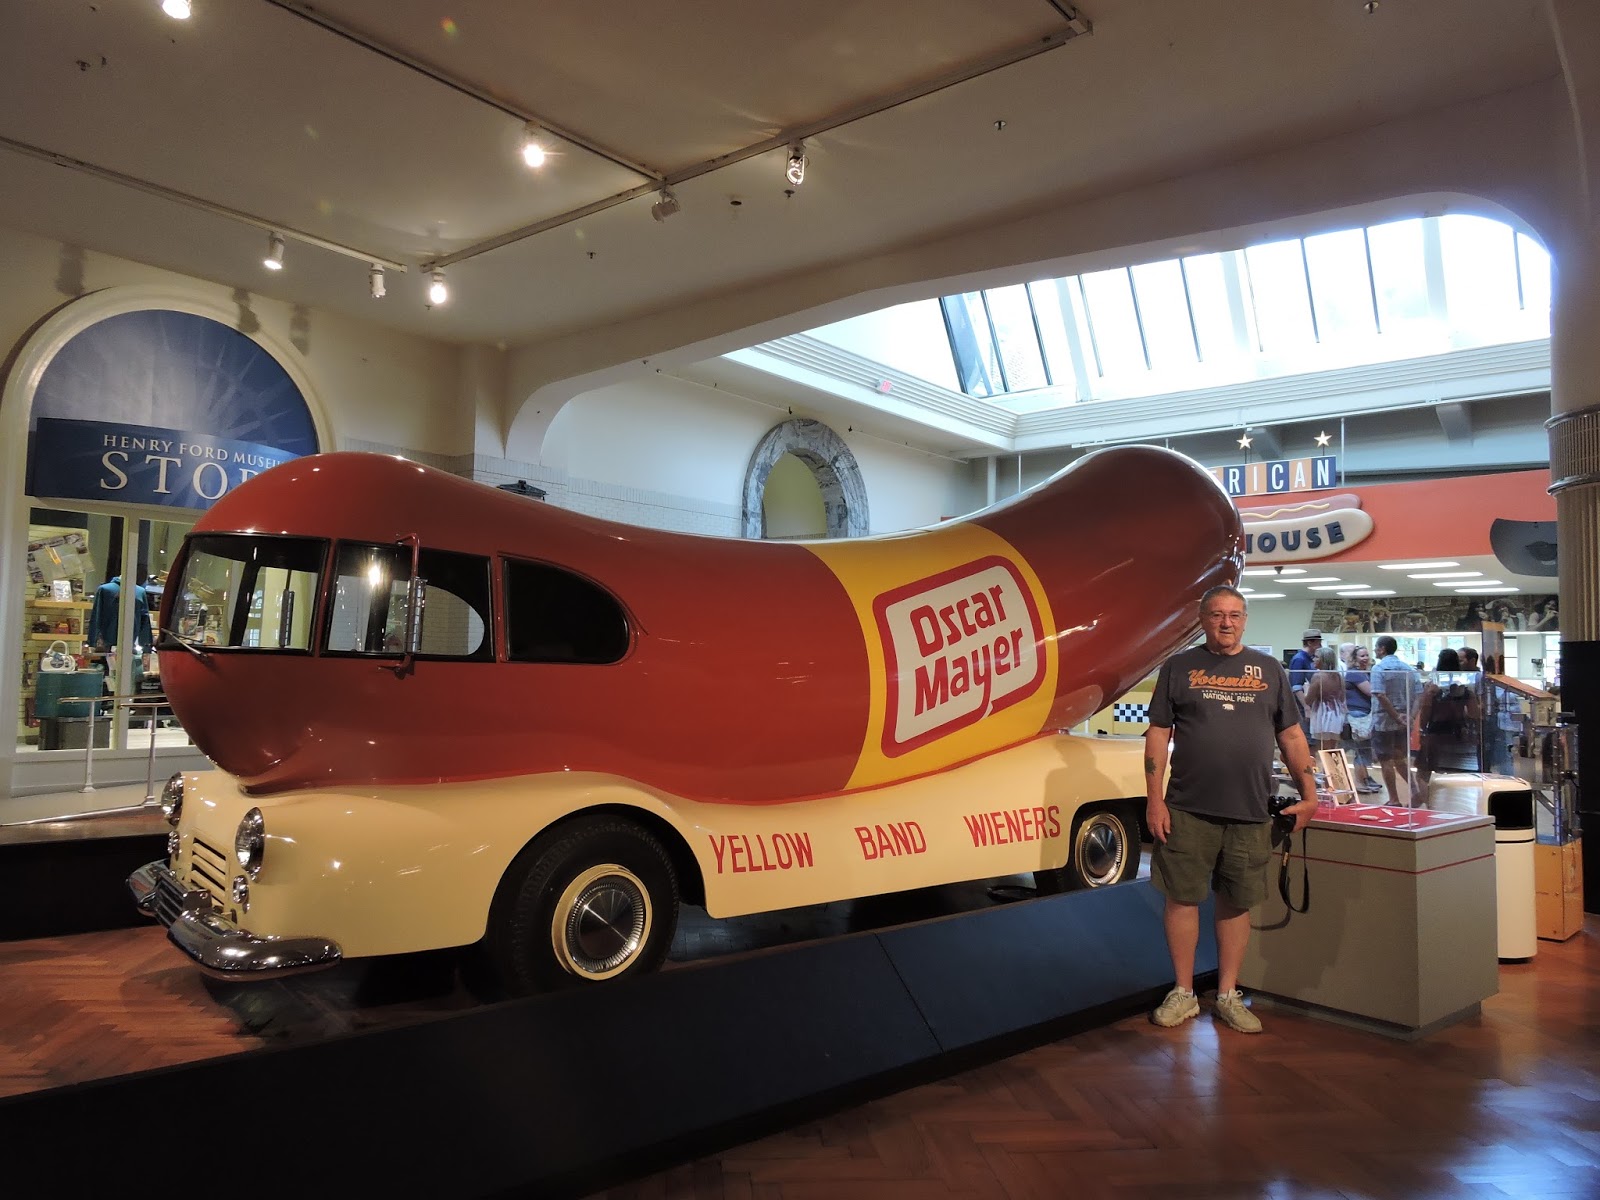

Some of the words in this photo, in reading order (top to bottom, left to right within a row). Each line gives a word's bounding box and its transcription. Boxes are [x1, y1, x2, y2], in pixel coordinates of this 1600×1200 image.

[104, 434, 173, 453] HENRY
[179, 442, 228, 461] FORD
[1212, 459, 1330, 494] RICAN
[909, 584, 1007, 657] Oscar
[914, 627, 1024, 718] Mayer
[1188, 669, 1268, 690] Yosemite
[1243, 664, 1262, 680] 90
[1202, 692, 1235, 702] NATIONAL
[1236, 695, 1256, 704] PARK
[708, 832, 814, 875] YELLOW
[854, 821, 927, 860] BAND
[963, 805, 1061, 848] WIENERS
